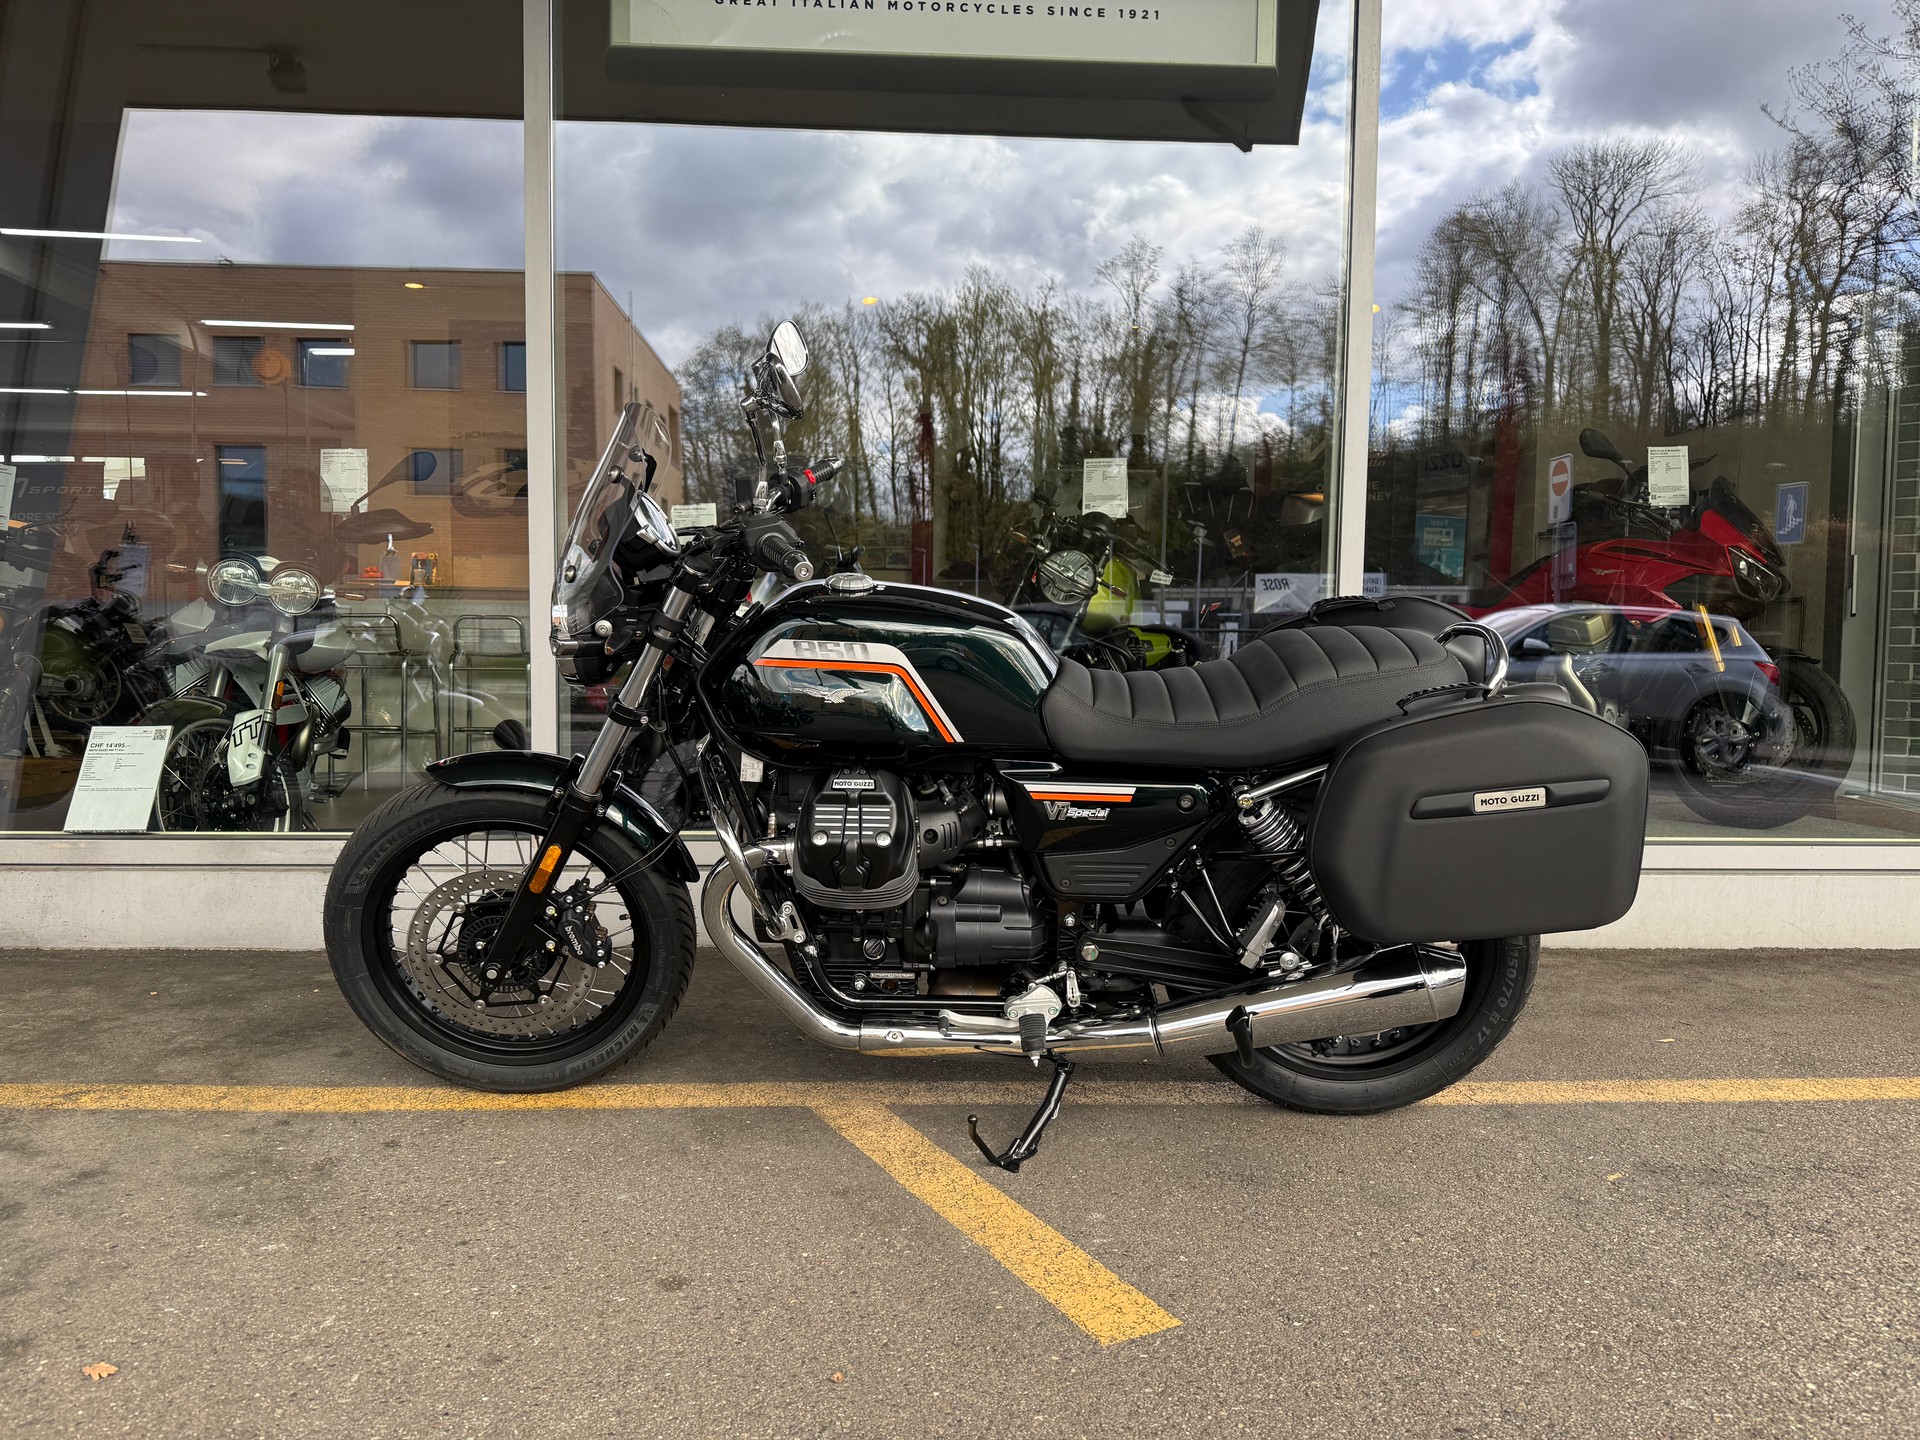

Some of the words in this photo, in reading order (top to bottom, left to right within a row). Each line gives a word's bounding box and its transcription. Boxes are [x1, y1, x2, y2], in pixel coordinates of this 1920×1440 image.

[792, 0, 874, 9] ITALIAN
[888, 0, 1034, 15] MOTORCYCLES
[1047, 6, 1106, 18] SINCE
[1118, 8, 1160, 20] 1921
[28, 485, 96, 494] SPORT
[231, 713, 263, 748] TT
[1043, 801, 1071, 820] V7
[1066, 807, 1111, 819] Special
[1481, 797, 1508, 806] MOTO
[1510, 794, 1540, 803] GUZZI
[362, 814, 436, 871] MICHELIN
[564, 925, 584, 956] brembo
[1497, 949, 1519, 1008] 150/70
[1477, 1025, 1491, 1045] 17
[569, 1024, 640, 1074] MICHELIN
